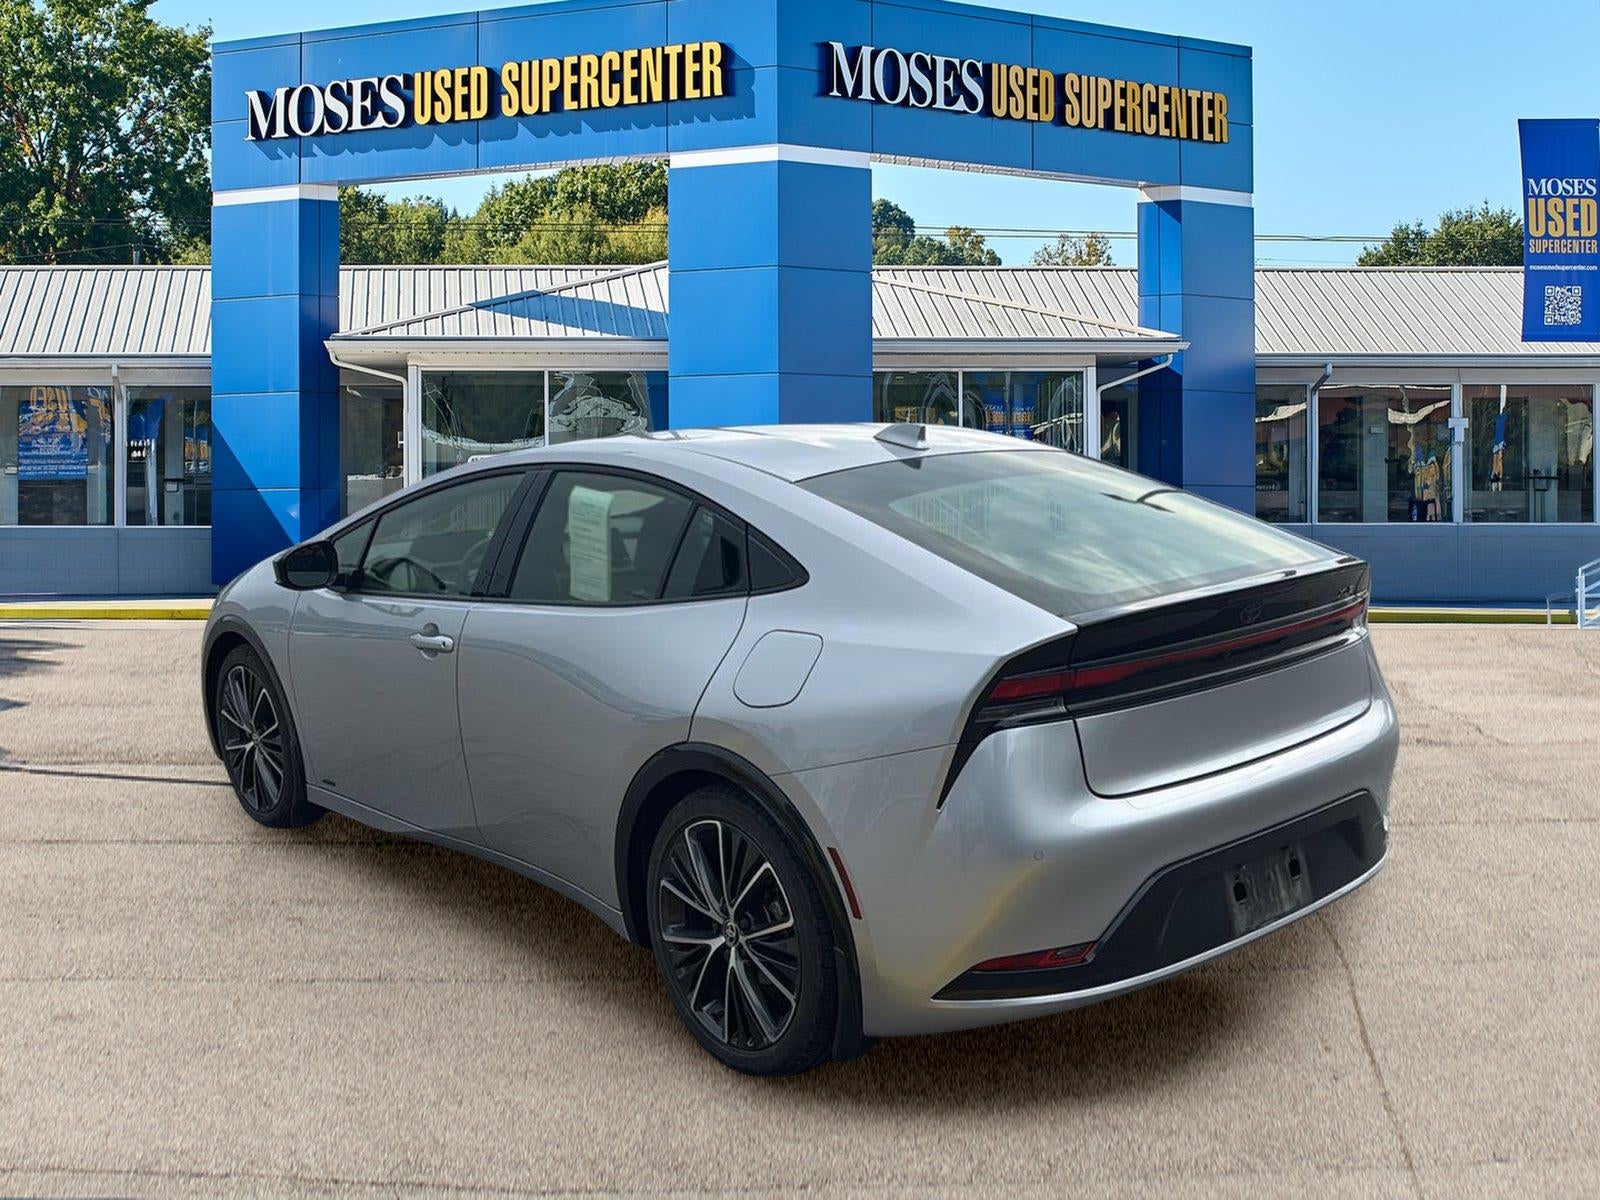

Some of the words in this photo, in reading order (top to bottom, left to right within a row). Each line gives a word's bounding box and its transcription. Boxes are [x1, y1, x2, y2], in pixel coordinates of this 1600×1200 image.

[244, 74, 405, 141] MOSES
[413, 66, 488, 125] USED
[500, 41, 723, 117] SUPERCENTER
[829, 41, 985, 114] MOSES
[991, 62, 1055, 122] USED
[1064, 72, 1229, 143] SUPERCENTER
[1527, 178, 1597, 196] MOSES
[1528, 198, 1598, 238] USED
[1529, 239, 1598, 254] SUPERCENTER
